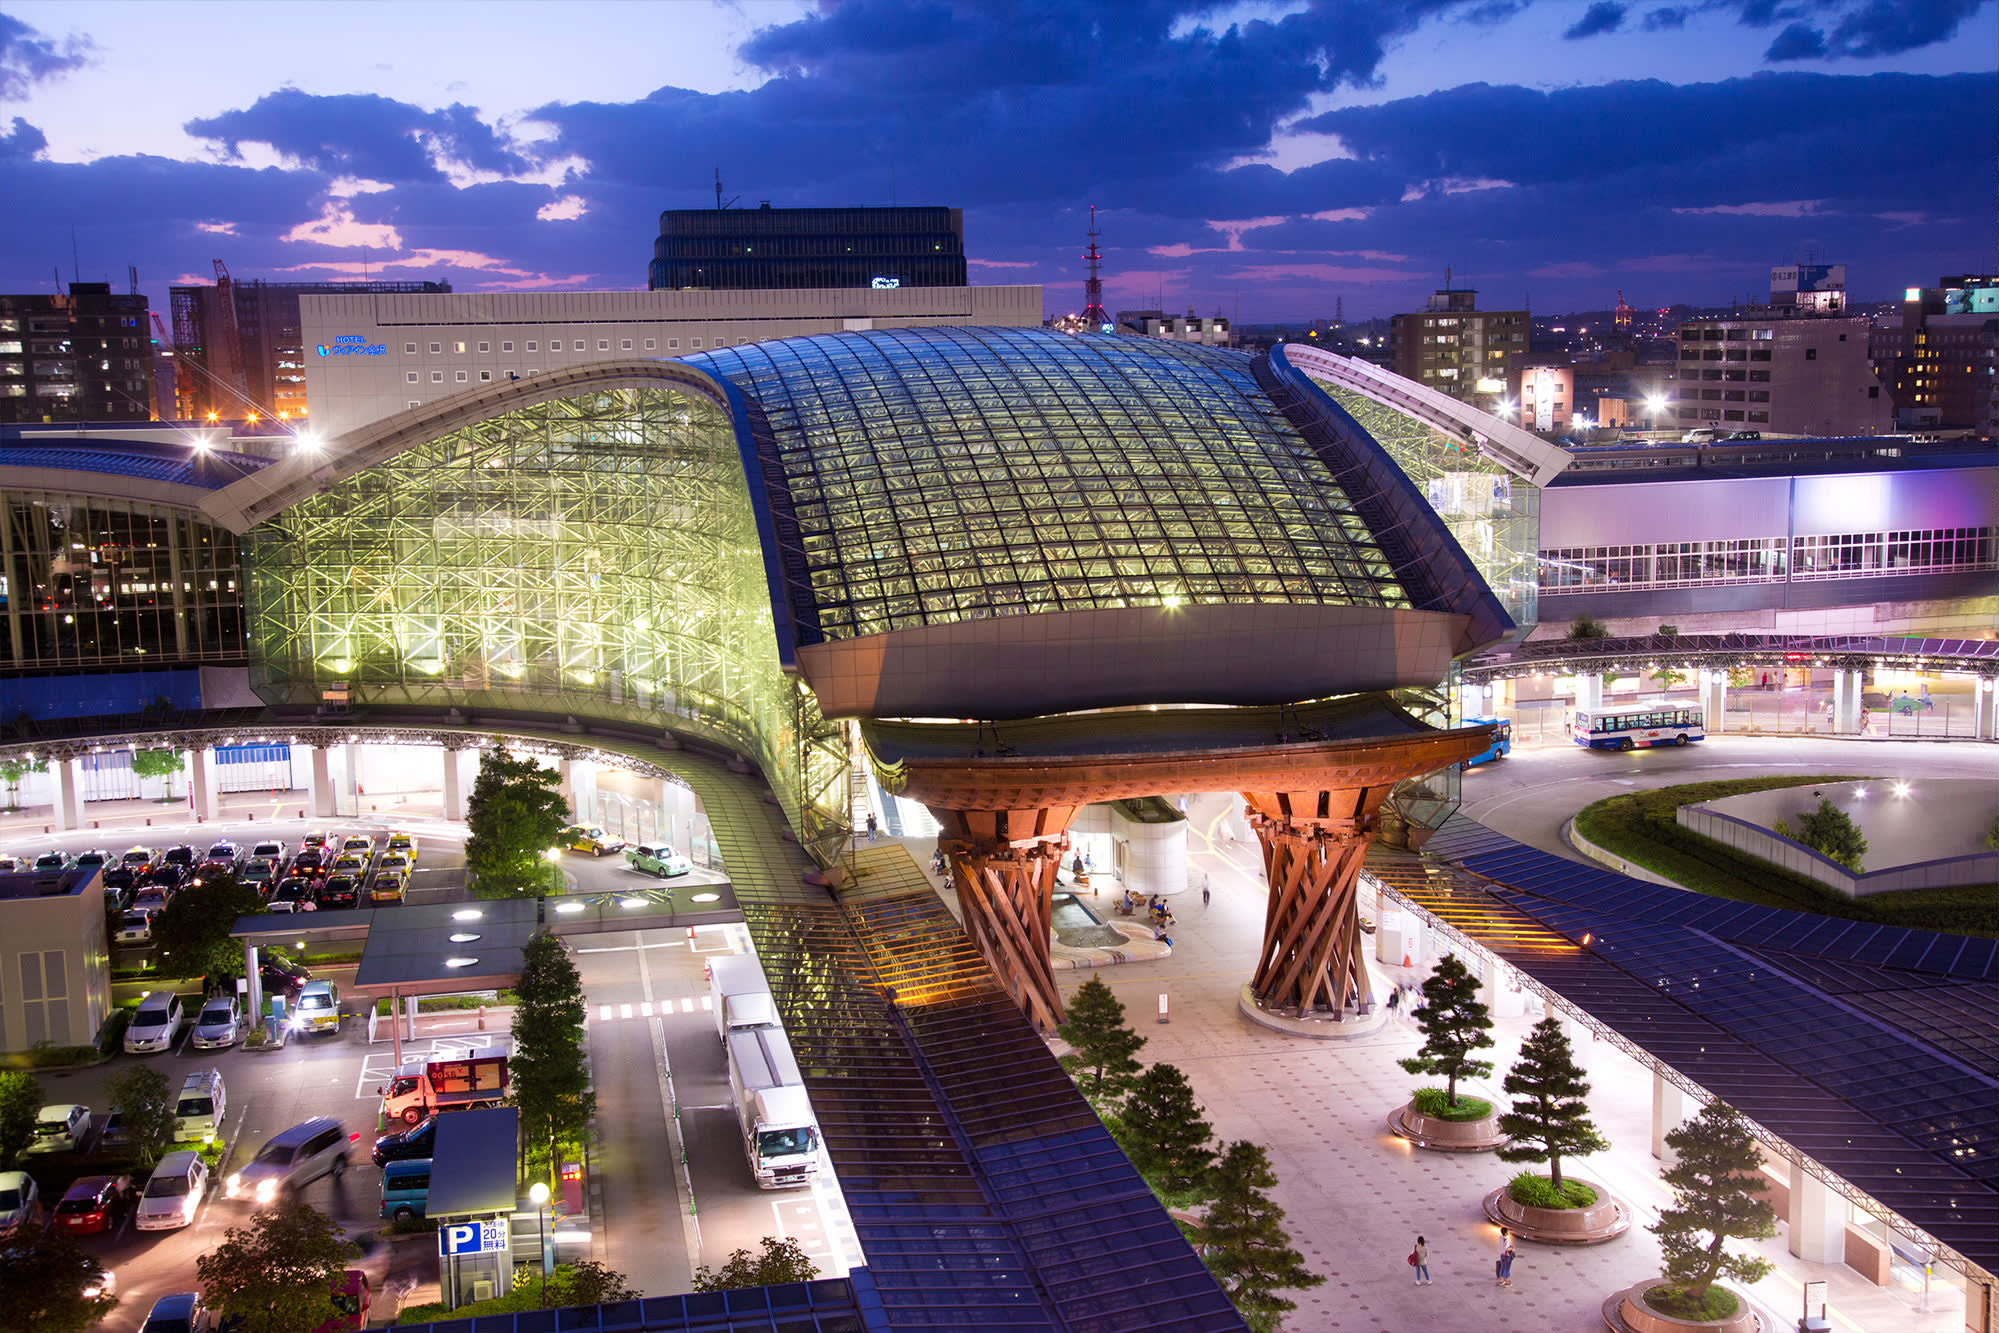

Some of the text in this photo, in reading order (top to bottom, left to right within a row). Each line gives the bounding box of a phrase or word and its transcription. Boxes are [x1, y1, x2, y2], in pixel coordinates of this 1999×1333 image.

[336, 336, 366, 344] HOTEL
[483, 1228, 506, 1239] 20分
[449, 1226, 474, 1253] P
[483, 1239, 506, 1251] 無料
